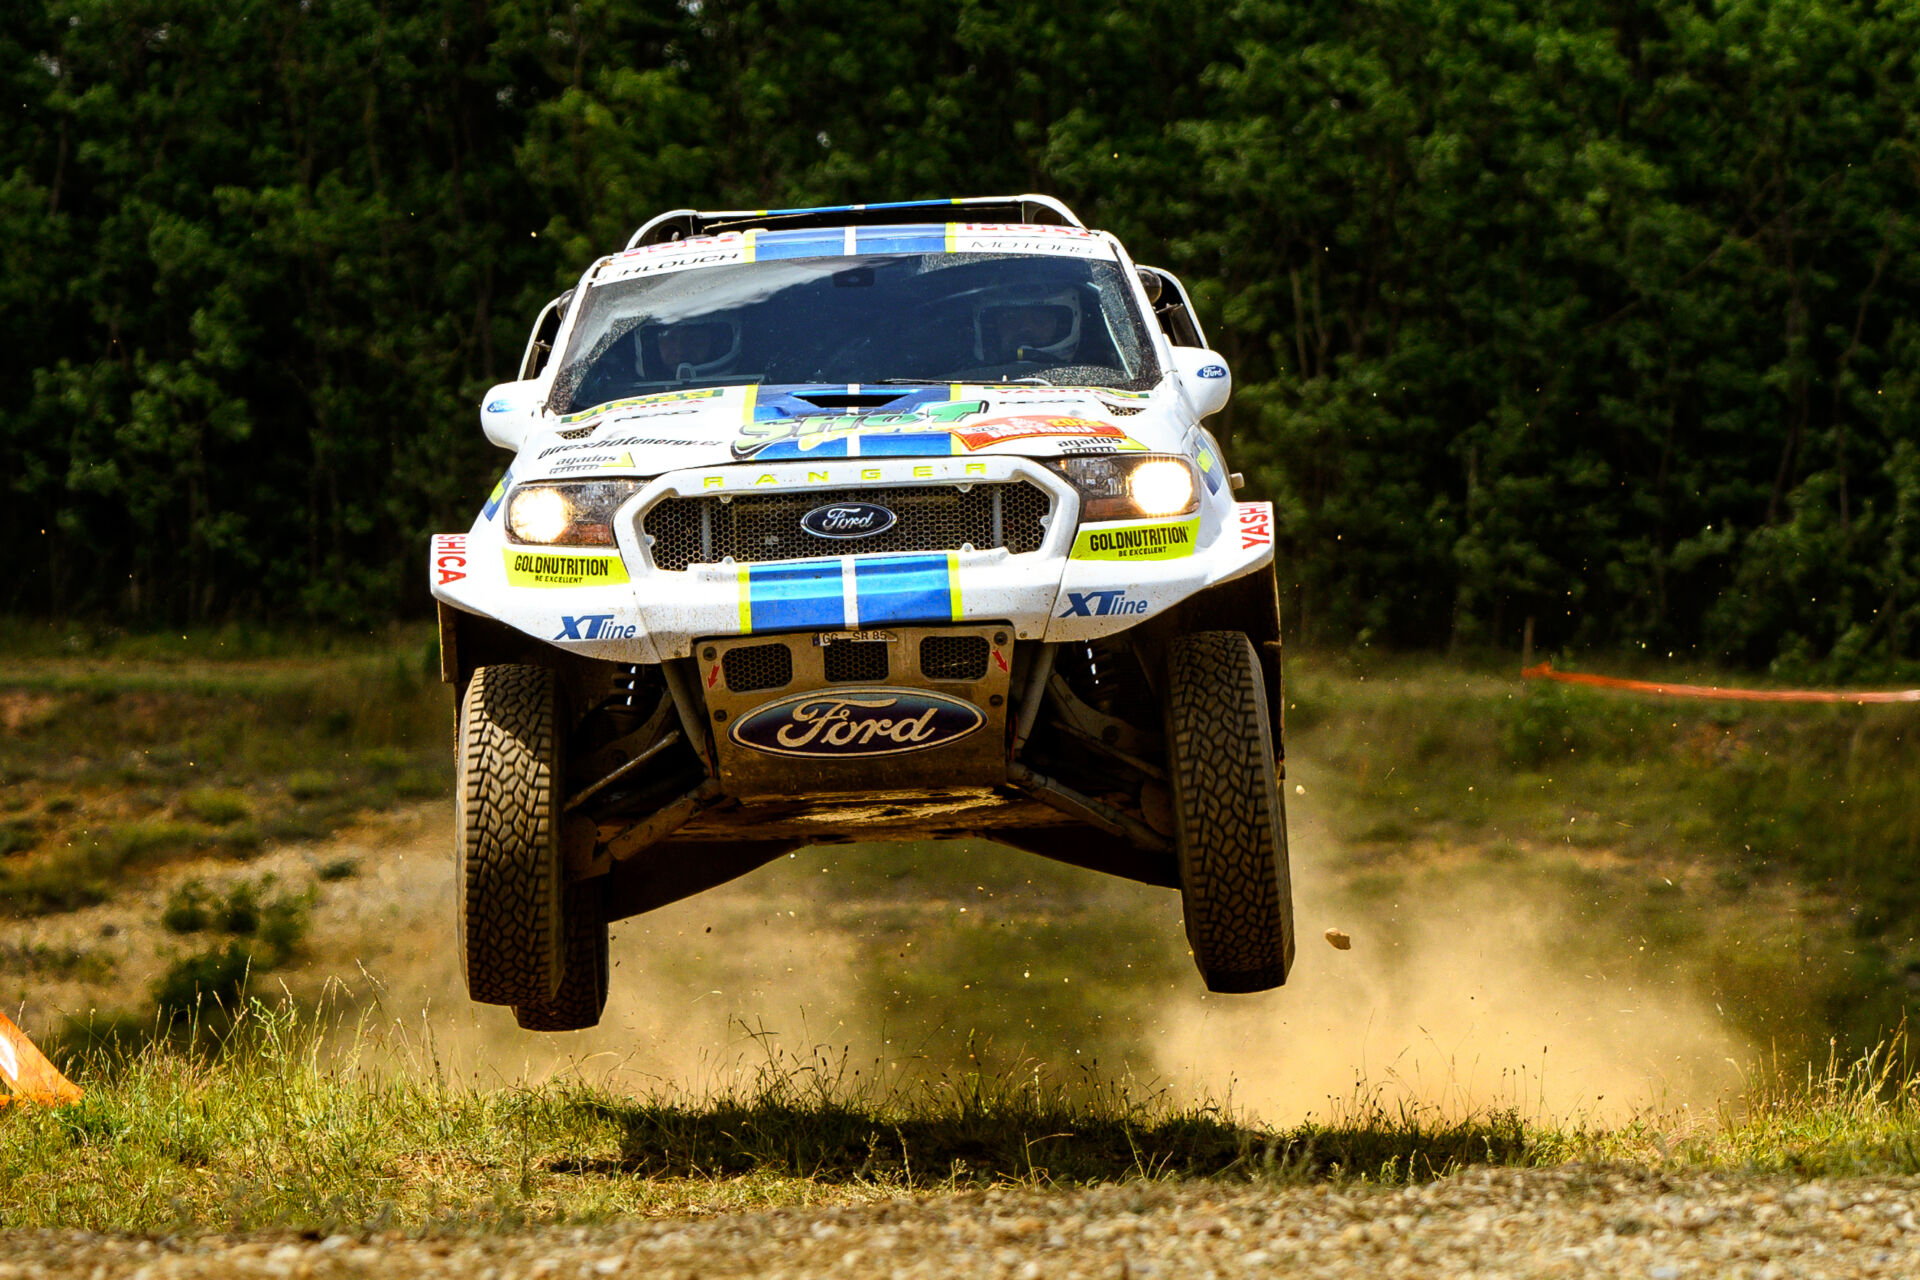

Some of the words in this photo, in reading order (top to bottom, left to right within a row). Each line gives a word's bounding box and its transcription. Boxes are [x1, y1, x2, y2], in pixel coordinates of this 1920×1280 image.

[703, 463, 987, 488] RANGER
[822, 508, 874, 529] Ford
[1090, 526, 1188, 552] GOLDNUTRITION
[1129, 546, 1167, 556] EXCELLENT
[514, 555, 609, 576] GOLDNUTRITION
[544, 575, 583, 584] EXCELLENT
[1058, 590, 1148, 618] XTline
[553, 614, 636, 640] XTline
[777, 698, 938, 748] Ford
